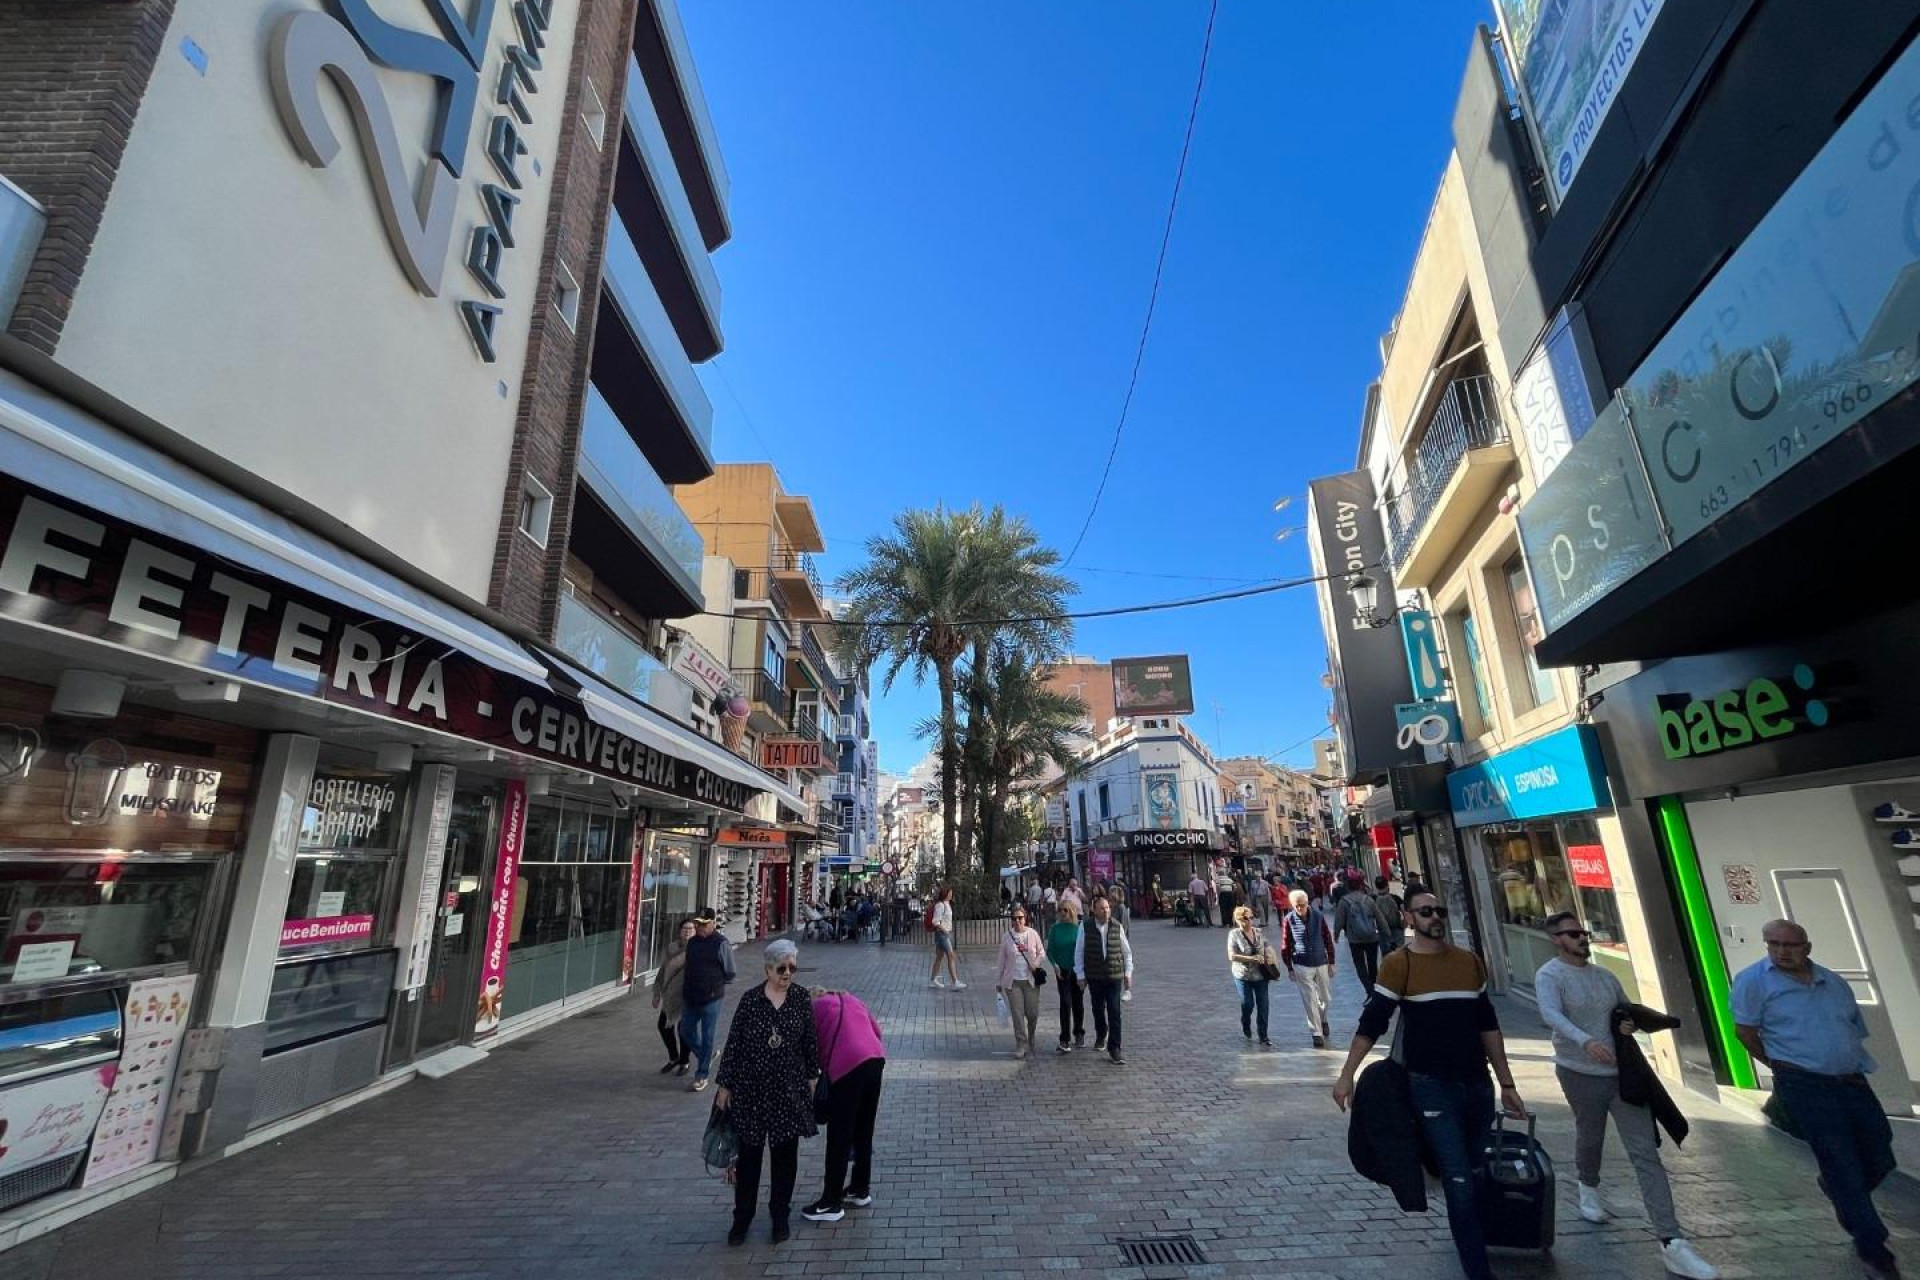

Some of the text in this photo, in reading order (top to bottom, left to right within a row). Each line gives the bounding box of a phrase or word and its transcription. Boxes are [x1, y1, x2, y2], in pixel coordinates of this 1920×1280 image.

[1572, 27, 1634, 155] PROYECTOS
[1336, 500, 1360, 543] City
[511, 696, 676, 789] CERVECERIA
[695, 768, 754, 811] CHOCOL
[766, 744, 820, 765] TATTOO
[310, 779, 395, 813] ASTELERÍA
[1514, 764, 1559, 793] ESPINOSA
[1133, 832, 1206, 846] PINOCCHIO
[490, 791, 522, 970] Chocolate con Churros
